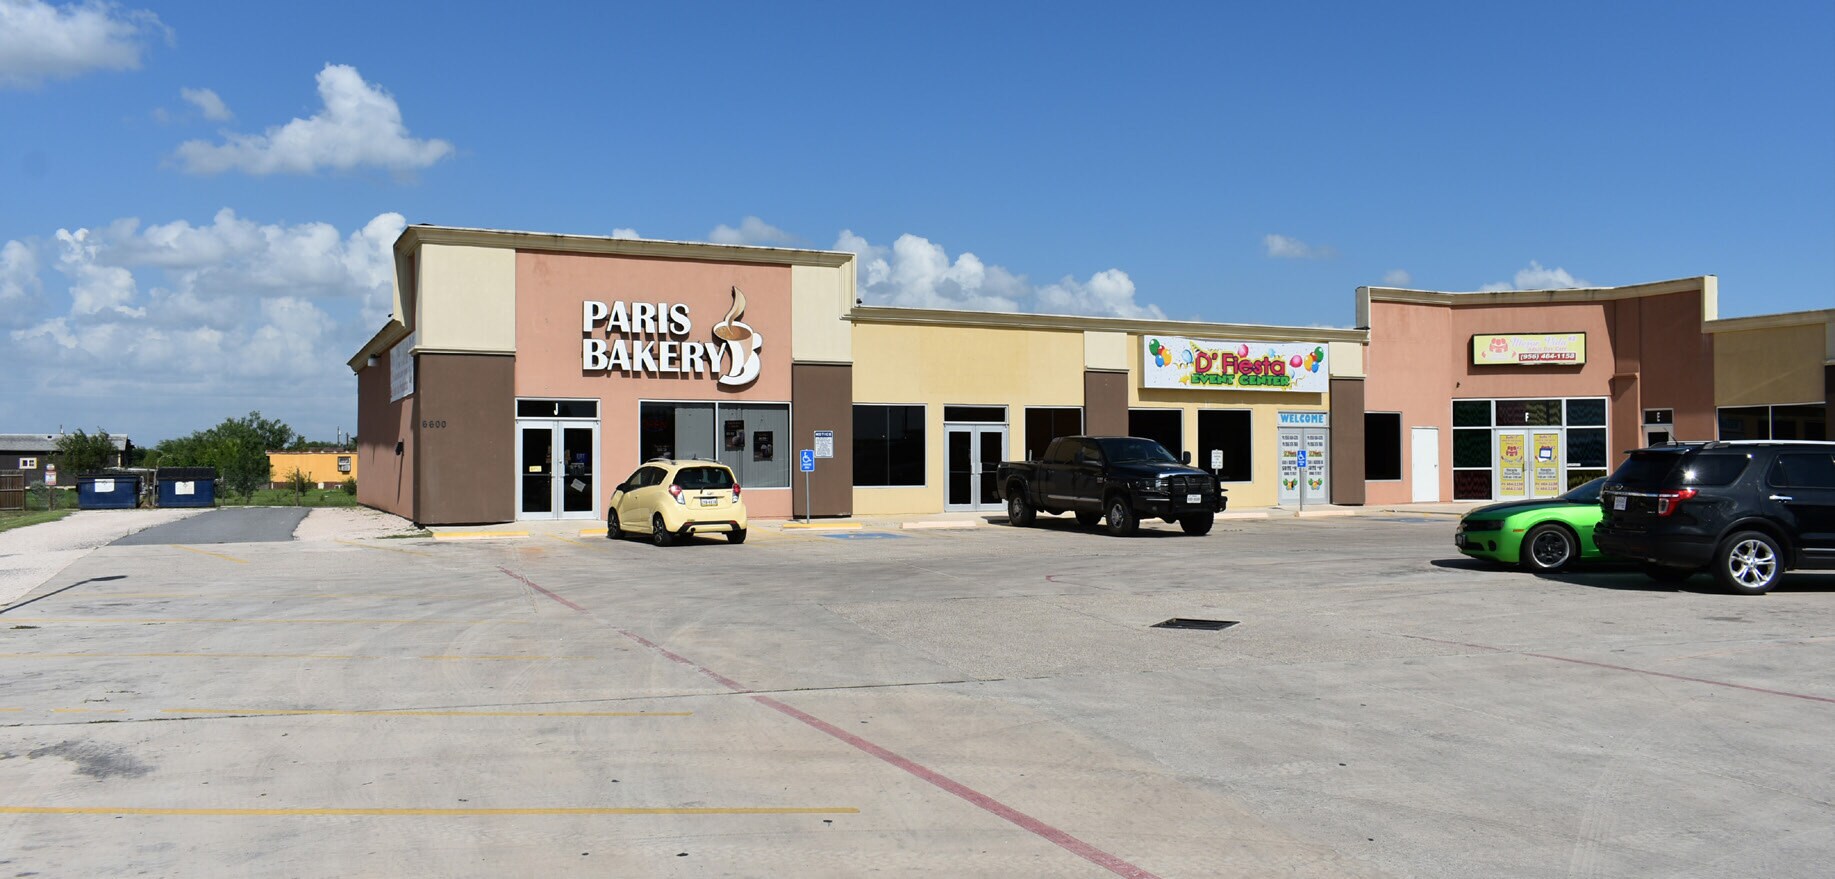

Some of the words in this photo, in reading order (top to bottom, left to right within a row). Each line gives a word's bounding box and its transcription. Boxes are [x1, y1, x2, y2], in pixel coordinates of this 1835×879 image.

[583, 301, 692, 335] PARIS
[583, 339, 727, 373] BAKERY
[1221, 353, 1286, 376] Fiesta
[1191, 373, 1235, 385] EVENT
[1238, 375, 1291, 387] CENTER
[554, 403, 559, 415] J
[1280, 414, 1324, 423] WELCOME
[1525, 412, 1530, 422] F
